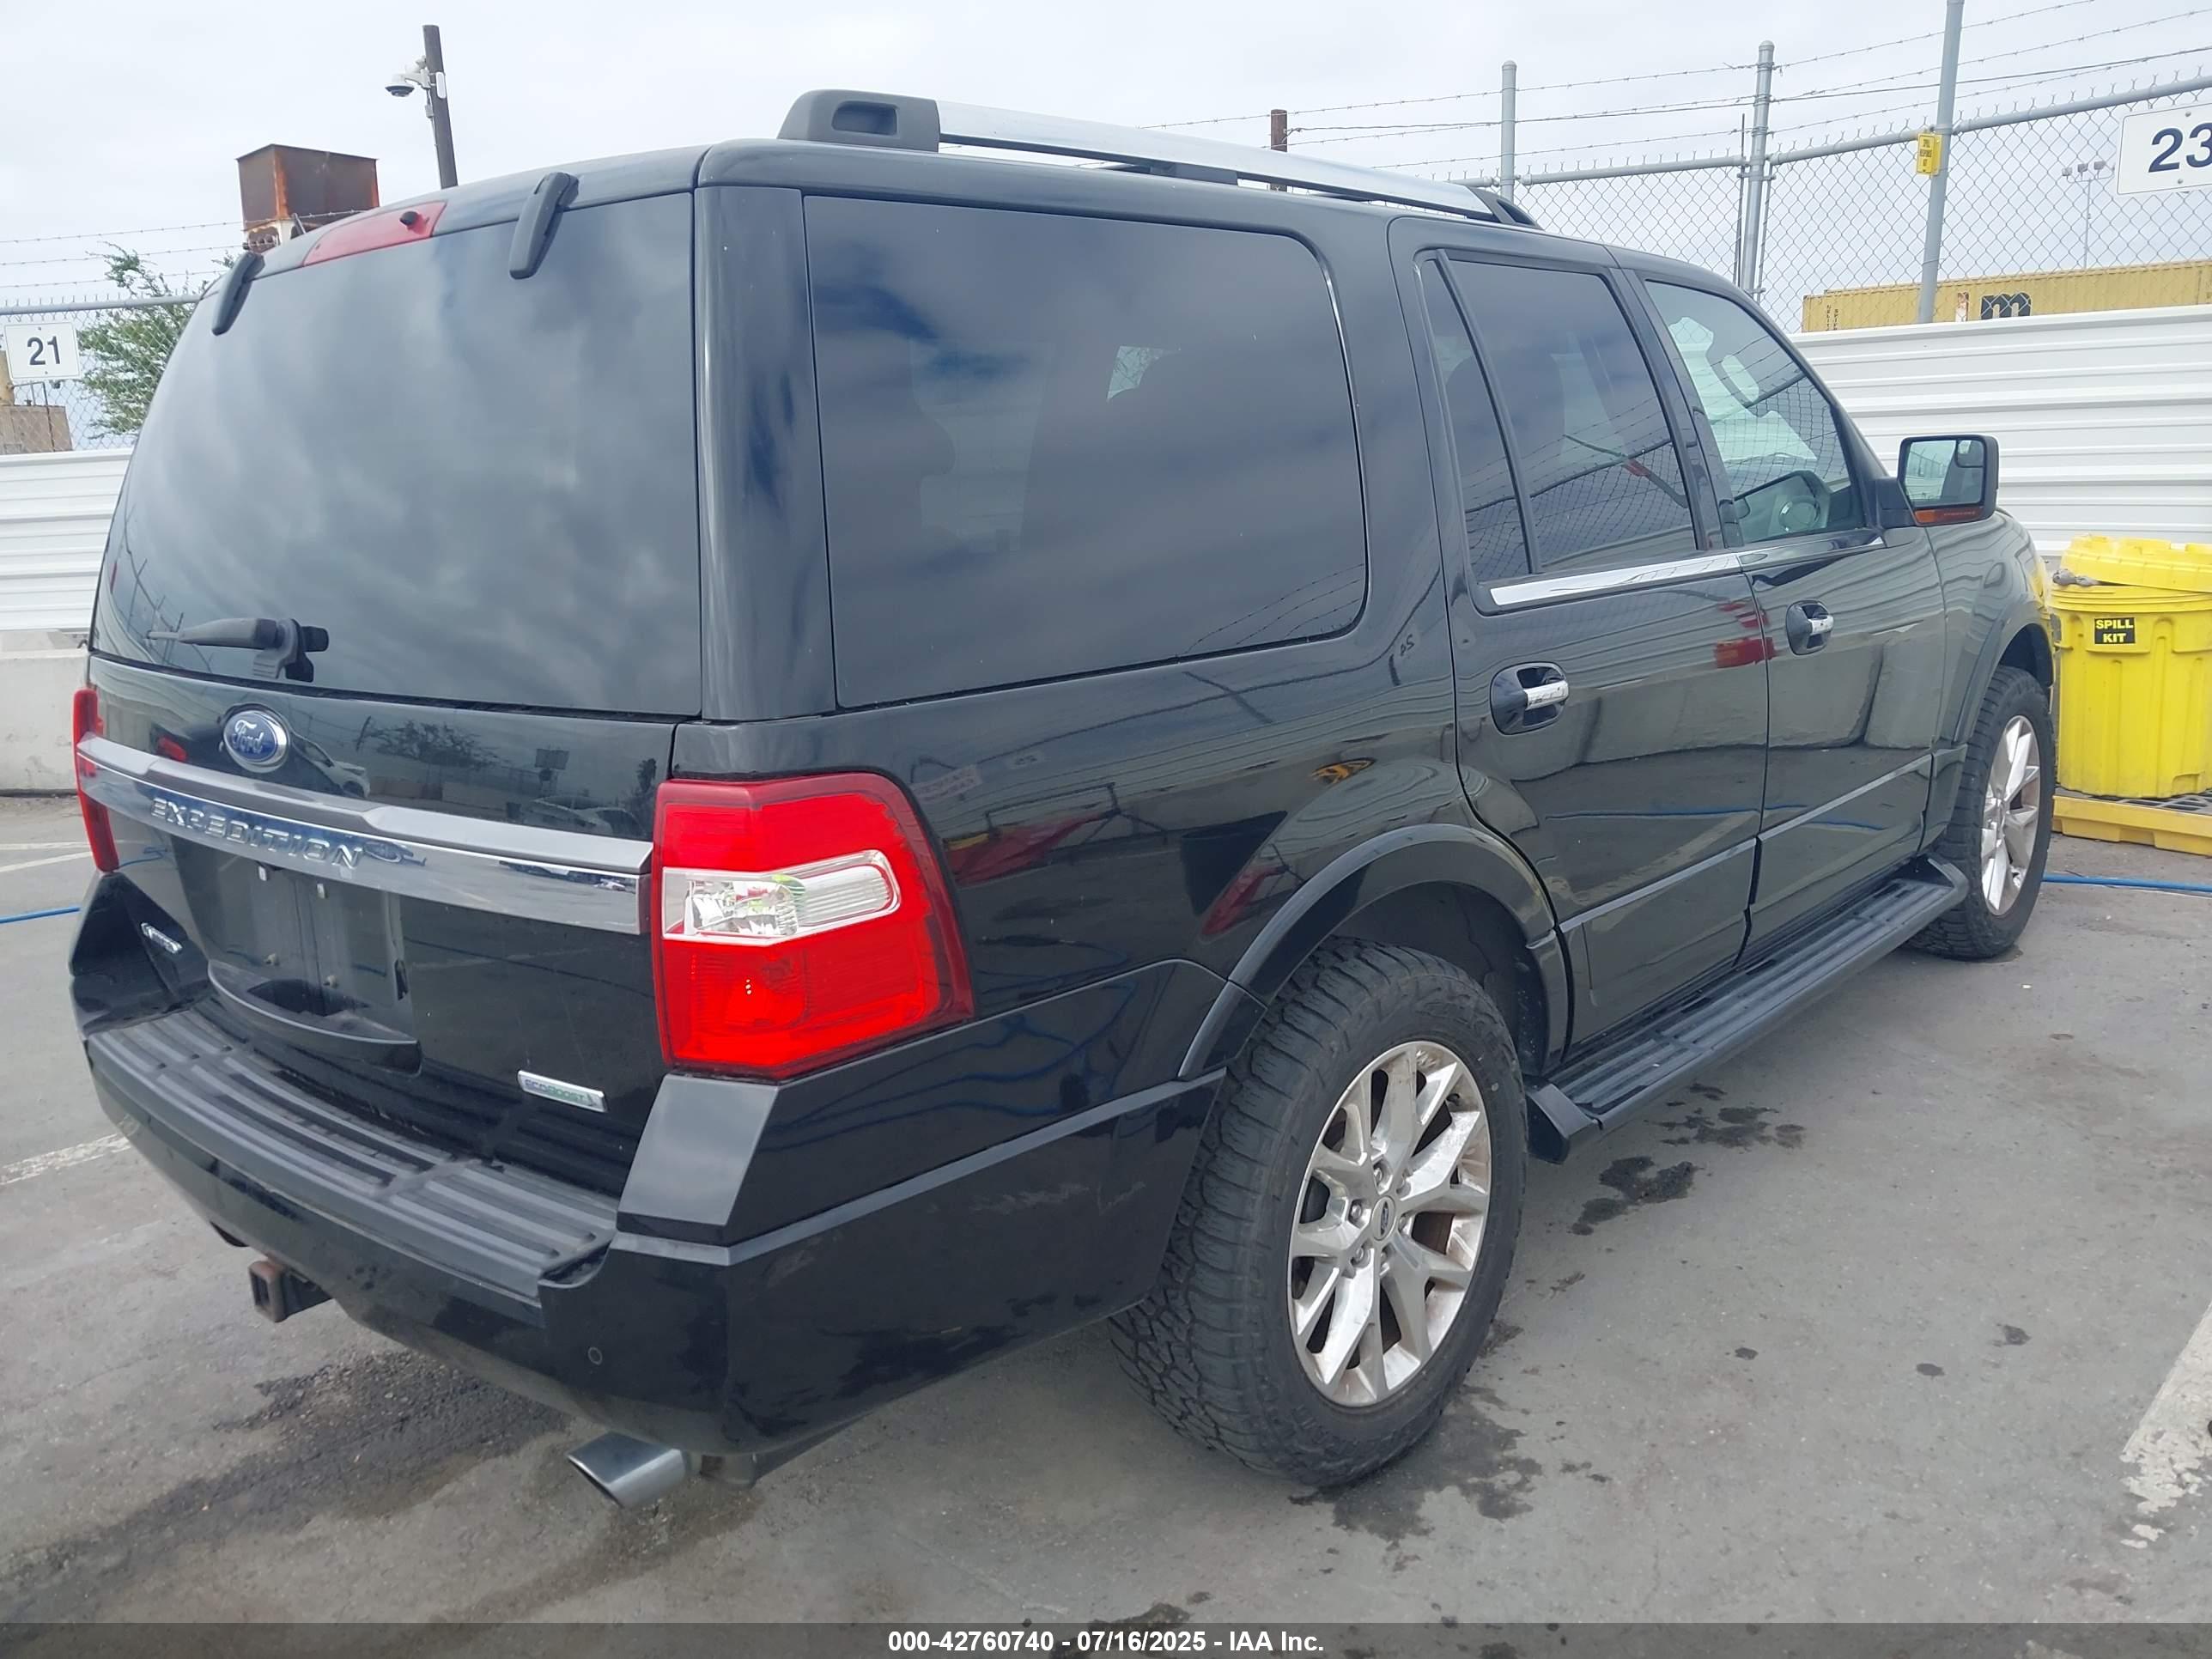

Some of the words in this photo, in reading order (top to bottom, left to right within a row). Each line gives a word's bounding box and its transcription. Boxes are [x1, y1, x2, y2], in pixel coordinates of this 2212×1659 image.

[2148, 122, 2212, 173] 23
[27, 336, 60, 365] 21
[2096, 619, 2134, 629] SPILL
[2103, 633, 2126, 642] KIT
[151, 797, 363, 870] EXPEDITION
